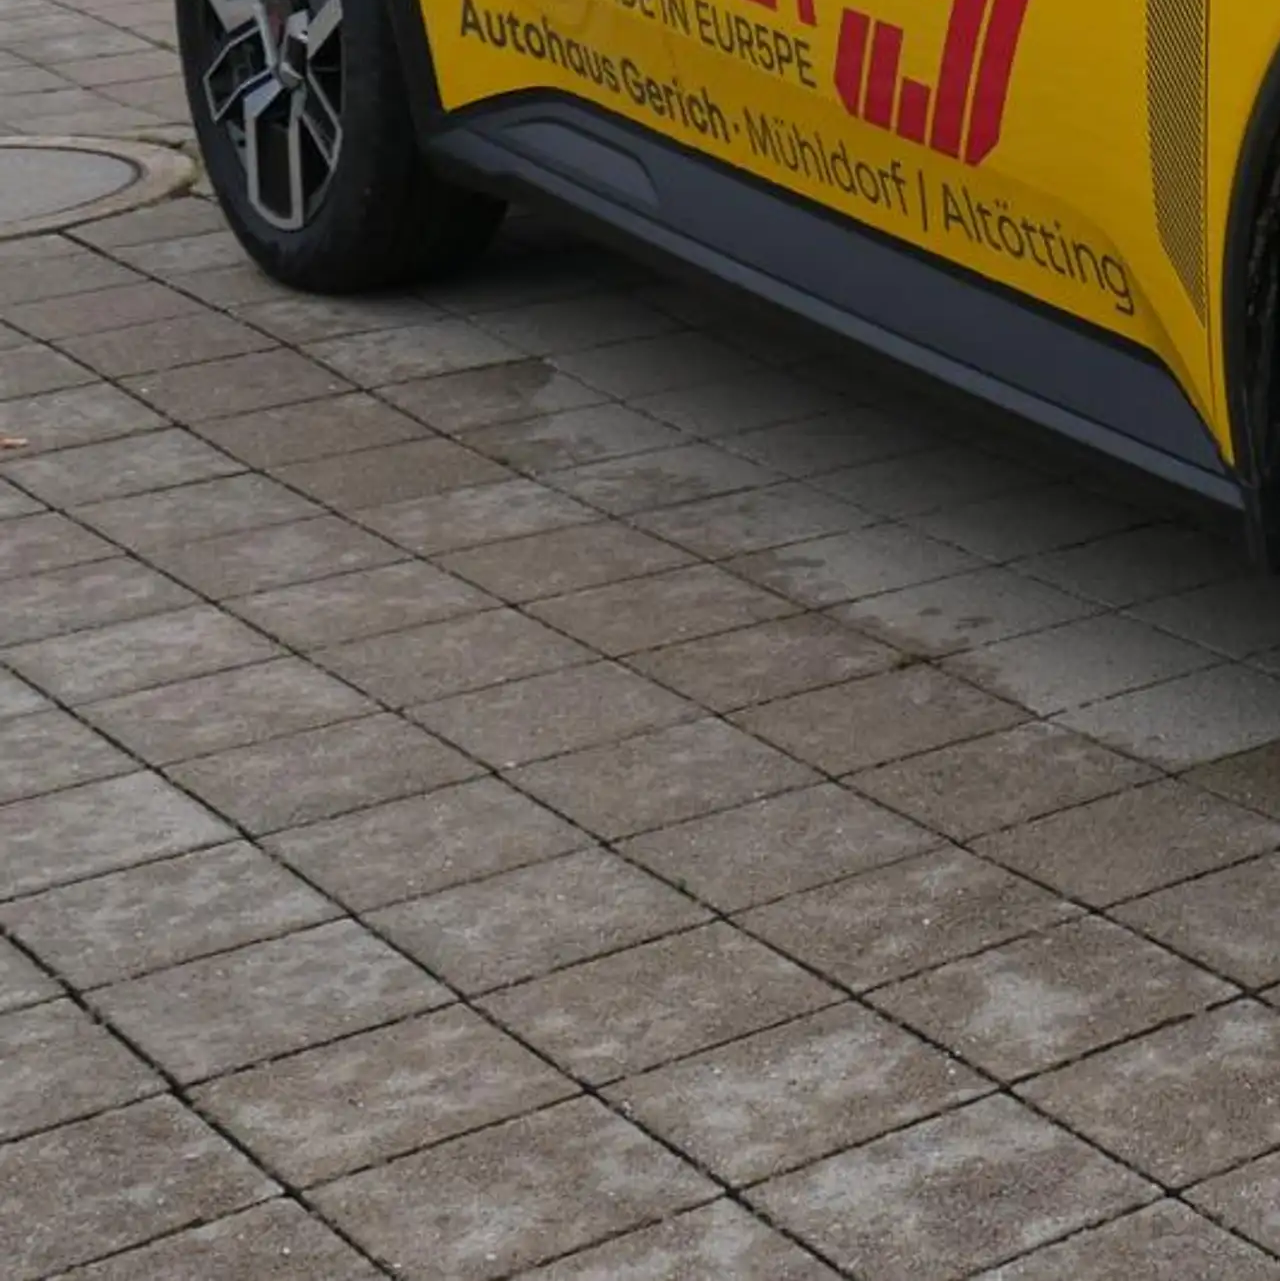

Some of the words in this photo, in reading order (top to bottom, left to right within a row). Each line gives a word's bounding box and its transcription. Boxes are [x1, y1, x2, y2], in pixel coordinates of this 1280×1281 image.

[621, 58, 732, 145] Gerich
[743, 105, 908, 216] Mühldorf
[942, 181, 1136, 318] Altötting
